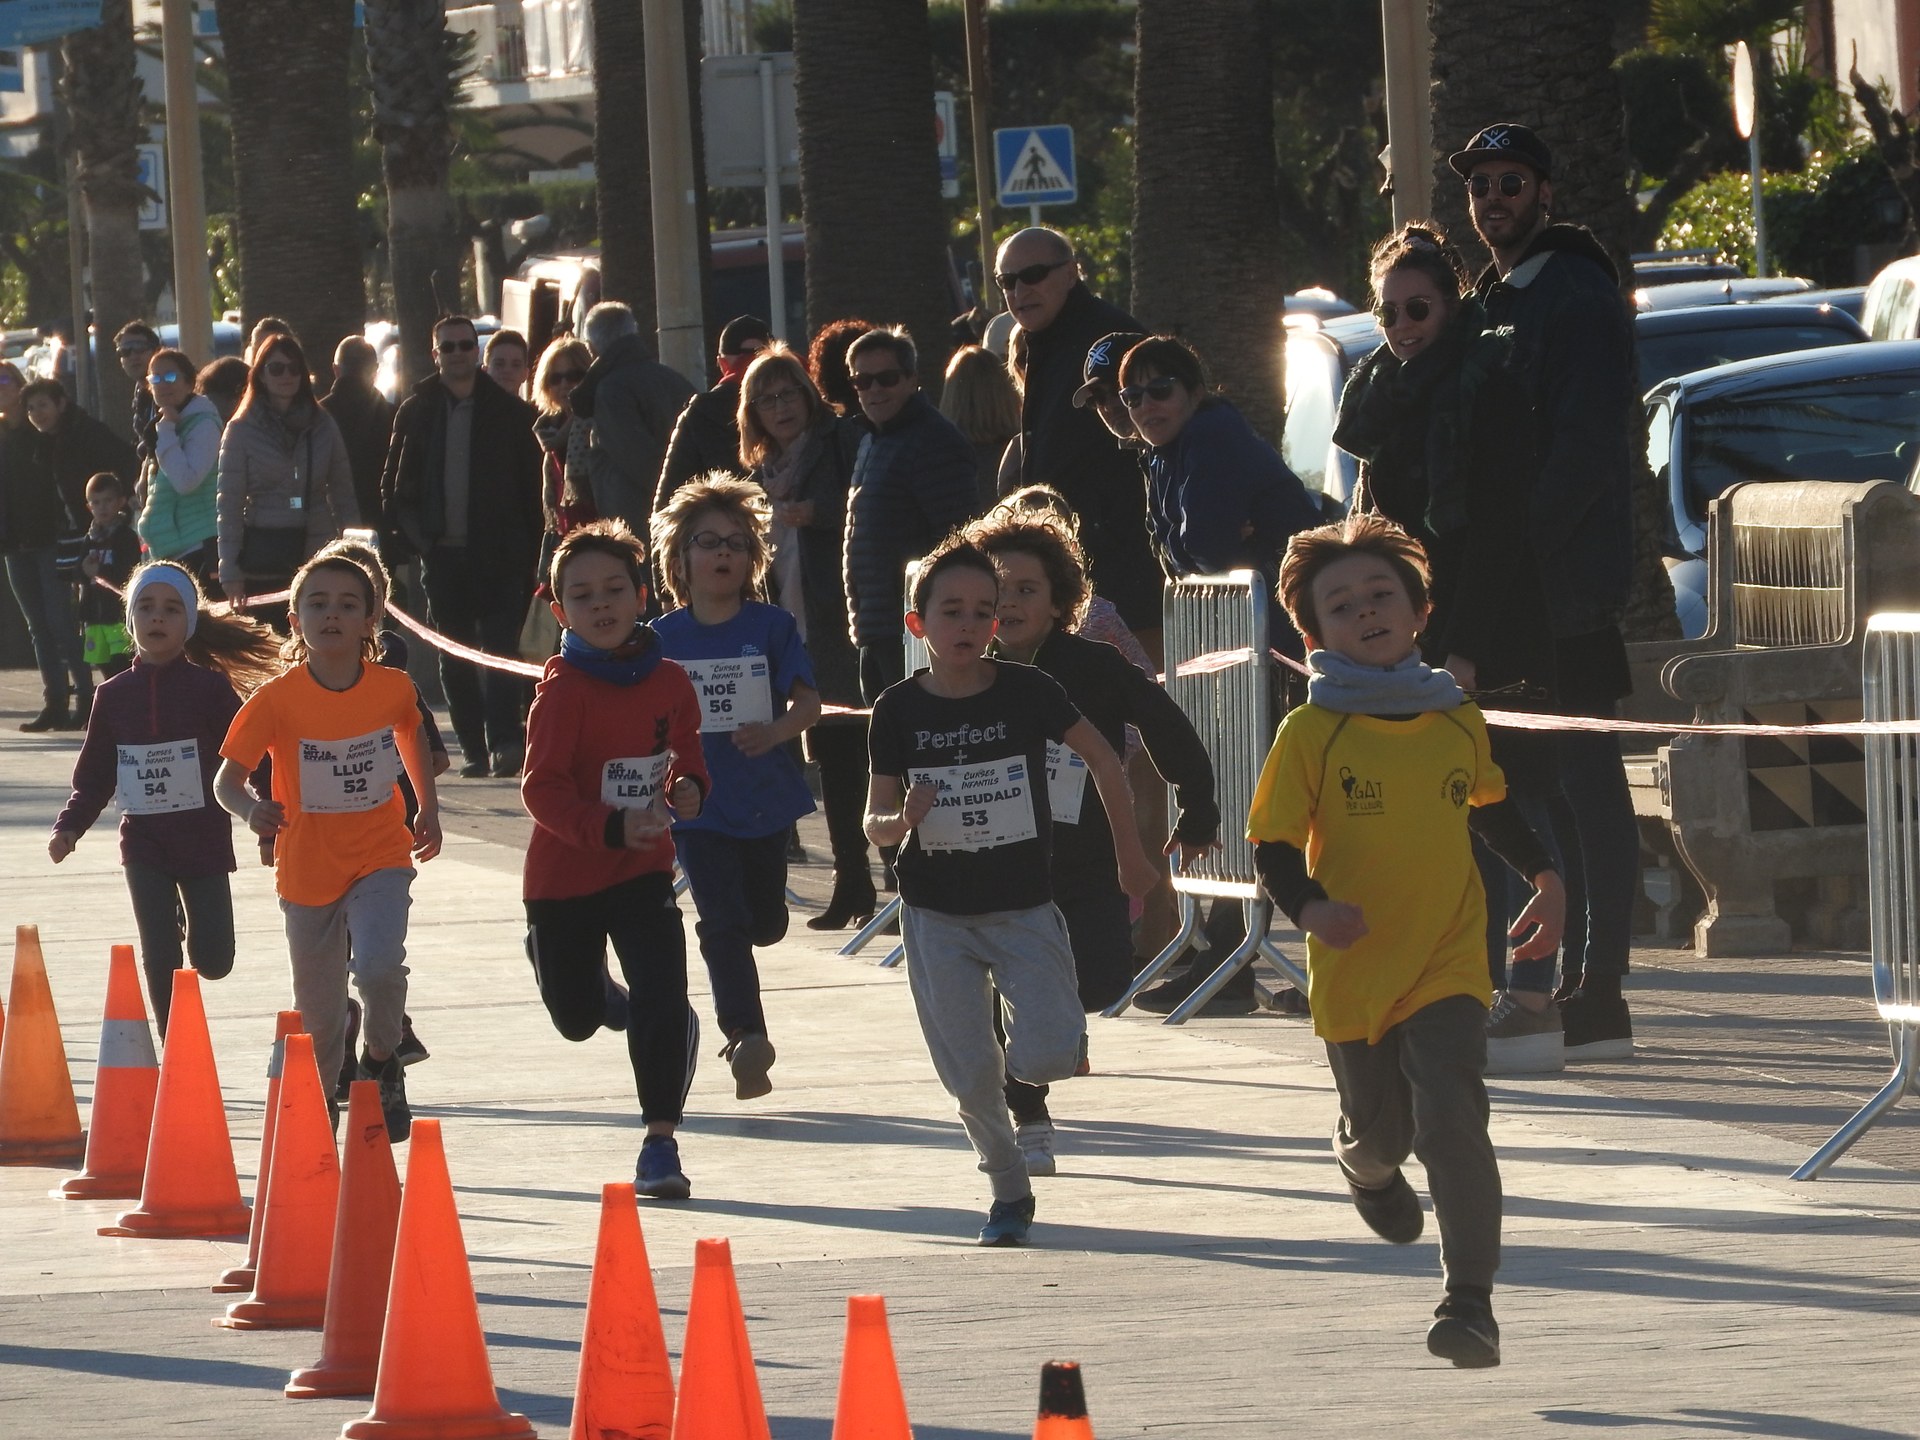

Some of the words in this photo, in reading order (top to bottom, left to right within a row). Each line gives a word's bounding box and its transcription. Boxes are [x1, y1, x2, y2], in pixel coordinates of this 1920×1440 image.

[703, 680, 736, 696] NOÉ
[709, 699, 733, 713] 56
[915, 721, 1006, 750] Perfect
[137, 767, 171, 780] LAIA
[332, 760, 374, 776] LLUC
[963, 768, 995, 780] CURSES
[914, 773, 930, 781] 36
[961, 777, 999, 790] INFANTILS
[144, 782, 167, 796] 54
[343, 778, 368, 793] 52
[1354, 780, 1383, 799] GAT
[932, 796, 961, 808] OAN
[964, 787, 1022, 805] EUDALD
[961, 810, 989, 827] 53
